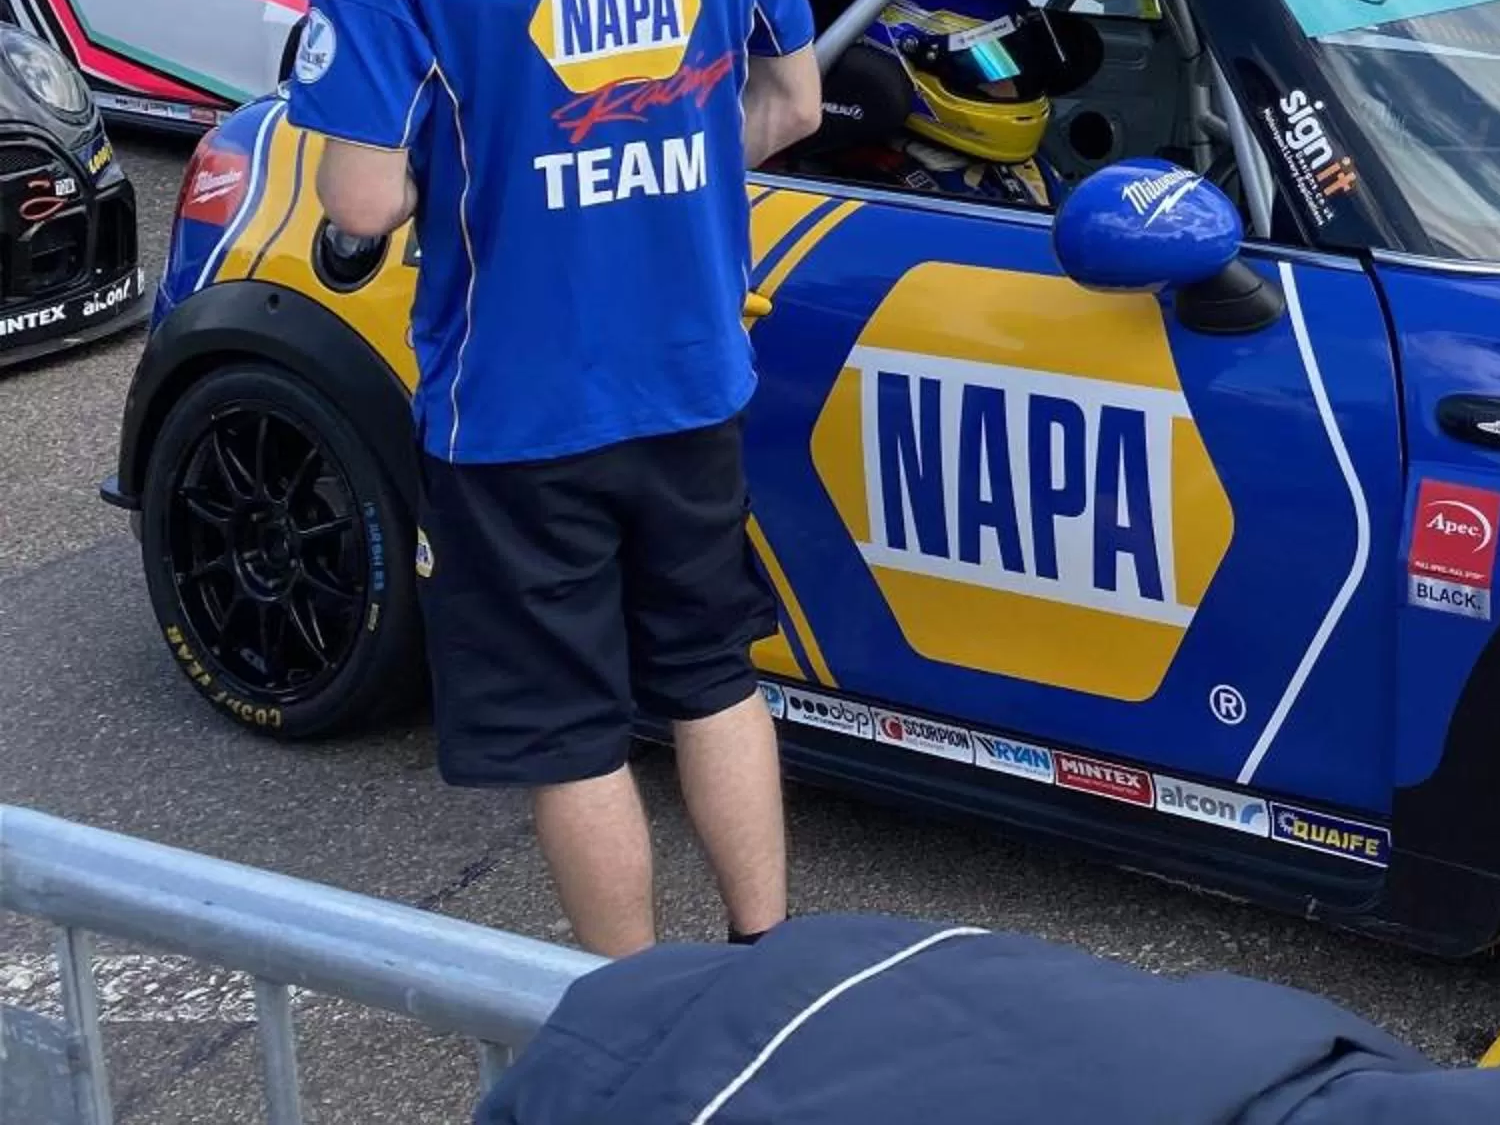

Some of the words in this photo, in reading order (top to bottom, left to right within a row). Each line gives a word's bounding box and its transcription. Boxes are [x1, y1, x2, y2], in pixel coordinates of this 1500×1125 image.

[552, 51, 736, 144] Racing
[534, 131, 707, 210] TEAM
[877, 371, 1166, 603] NAPA
[1426, 512, 1479, 536] Apec
[904, 718, 970, 750] SCORPION
[993, 740, 1050, 769] RYAN
[1062, 758, 1141, 789] MINTEX
[1161, 786, 1236, 823] alcon
[1292, 820, 1381, 857] QUAIFE
